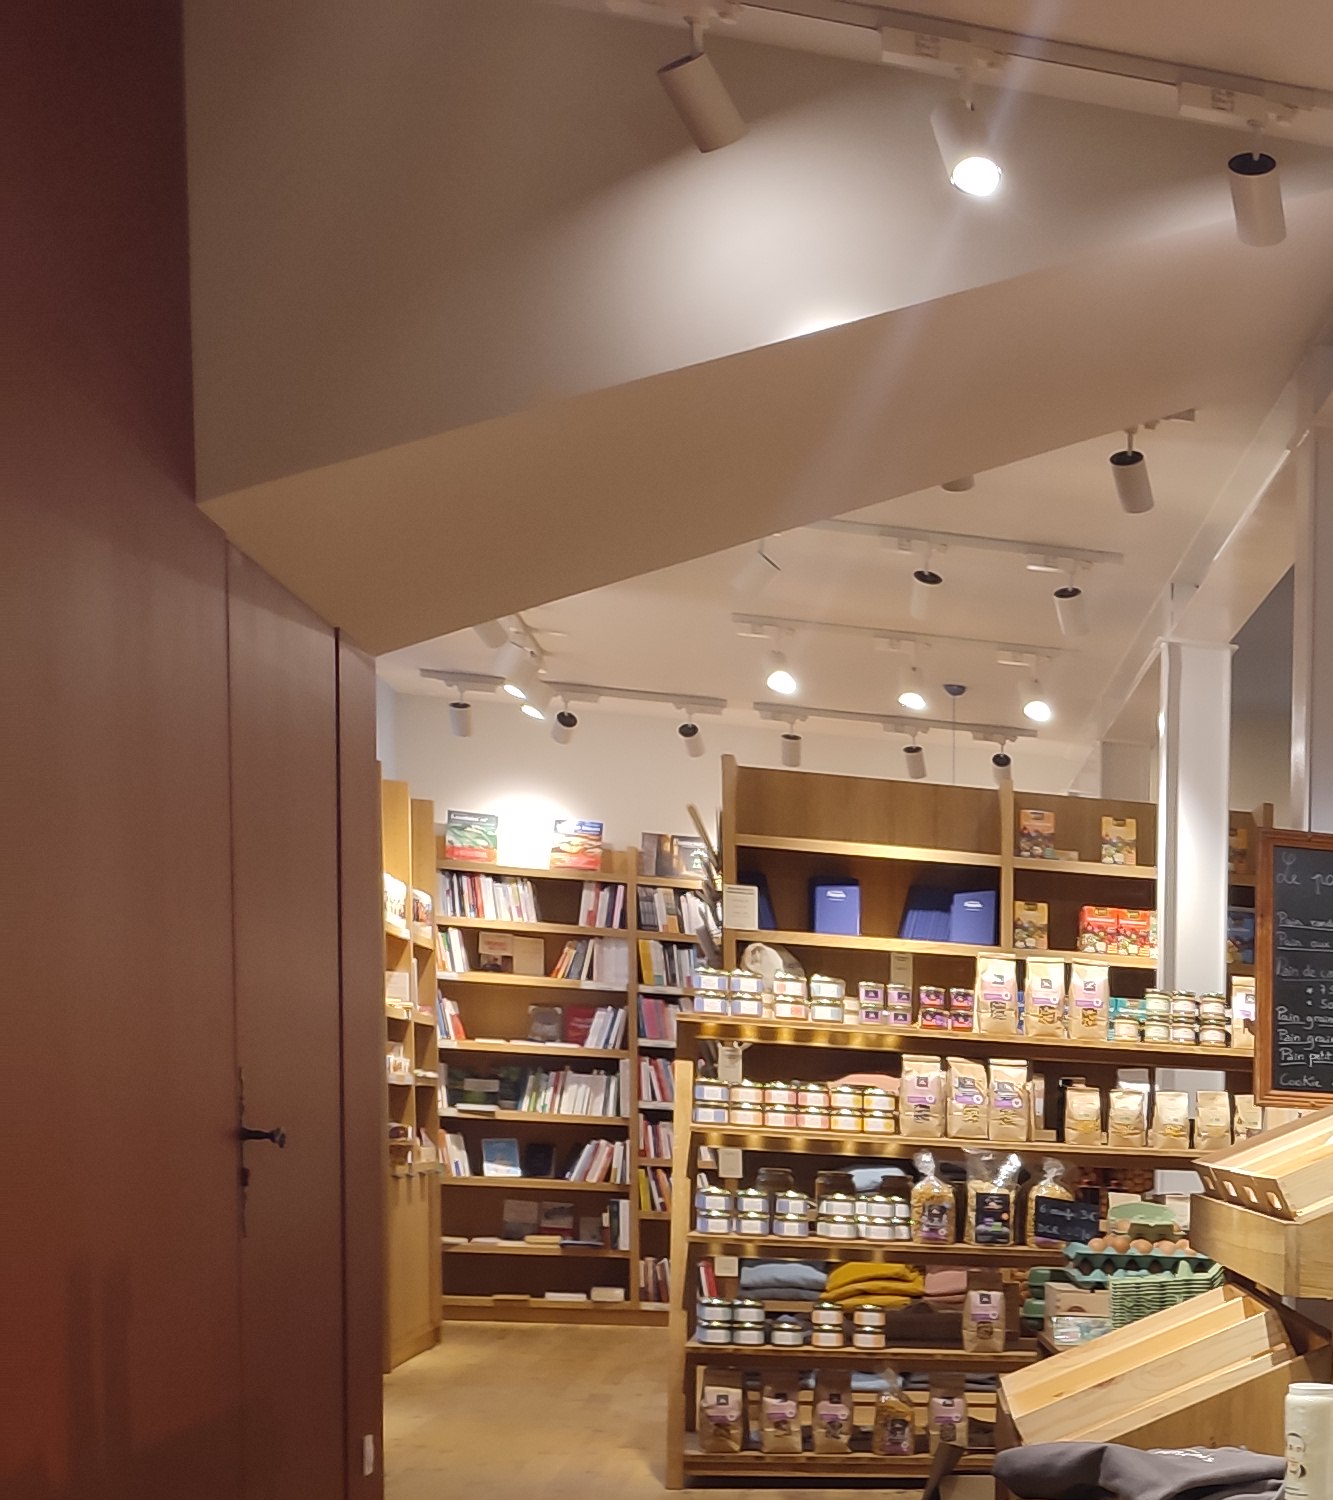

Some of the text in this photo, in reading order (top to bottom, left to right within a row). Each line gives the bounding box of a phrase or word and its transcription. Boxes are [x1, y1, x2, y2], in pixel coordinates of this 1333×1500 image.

[1277, 911, 1304, 926] Pain
[1276, 1006, 1300, 1022] Pain
[1277, 1028, 1301, 1043] Pain
[1279, 1047, 1305, 1061] Pain
